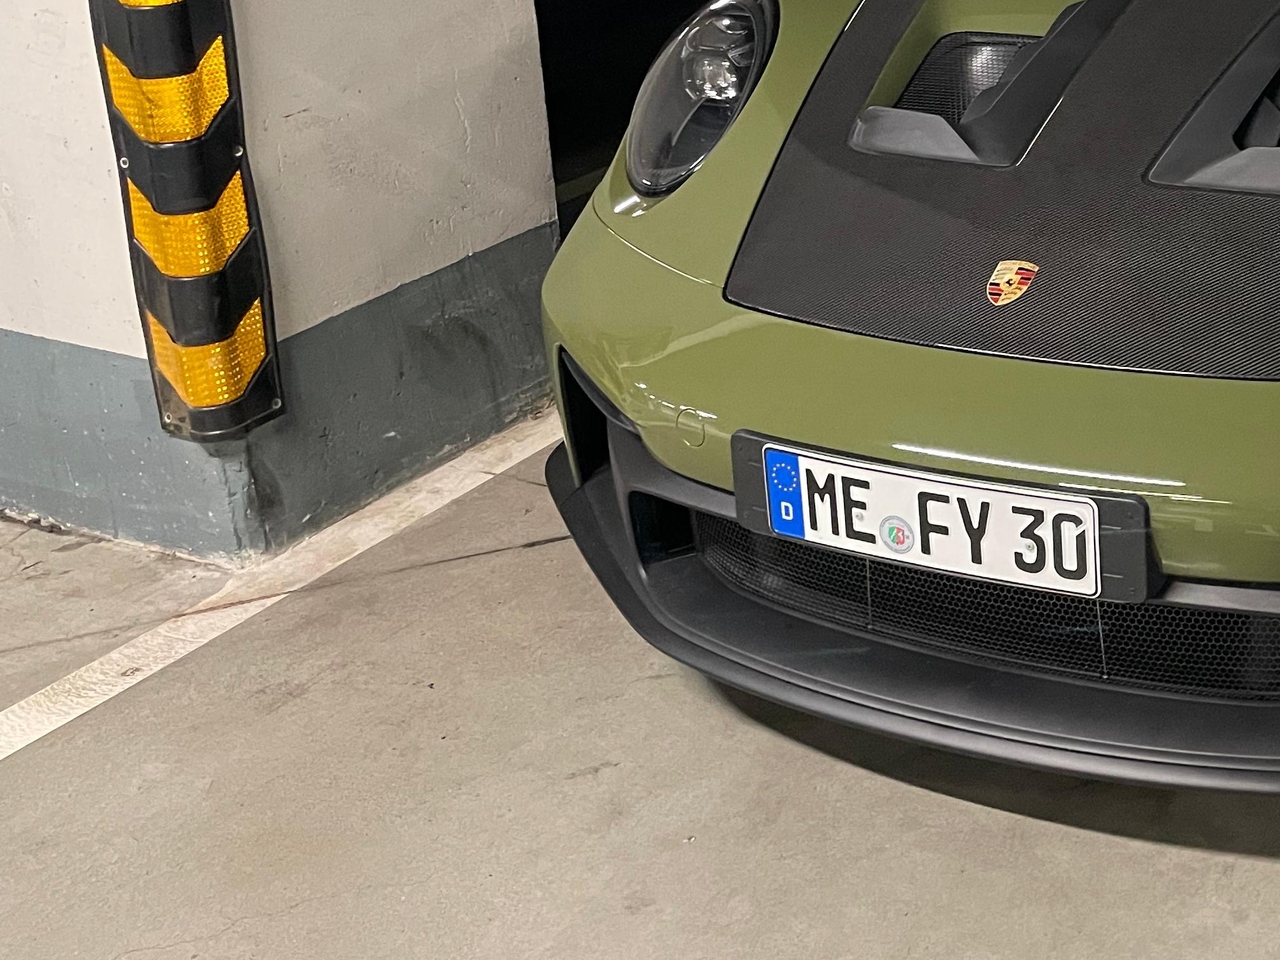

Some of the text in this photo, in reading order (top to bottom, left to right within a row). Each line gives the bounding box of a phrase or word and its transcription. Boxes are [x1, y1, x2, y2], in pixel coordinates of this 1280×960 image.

[781, 501, 794, 521] D
[805, 467, 877, 544] ME
[917, 491, 990, 565] FY
[1011, 505, 1088, 580] 30
